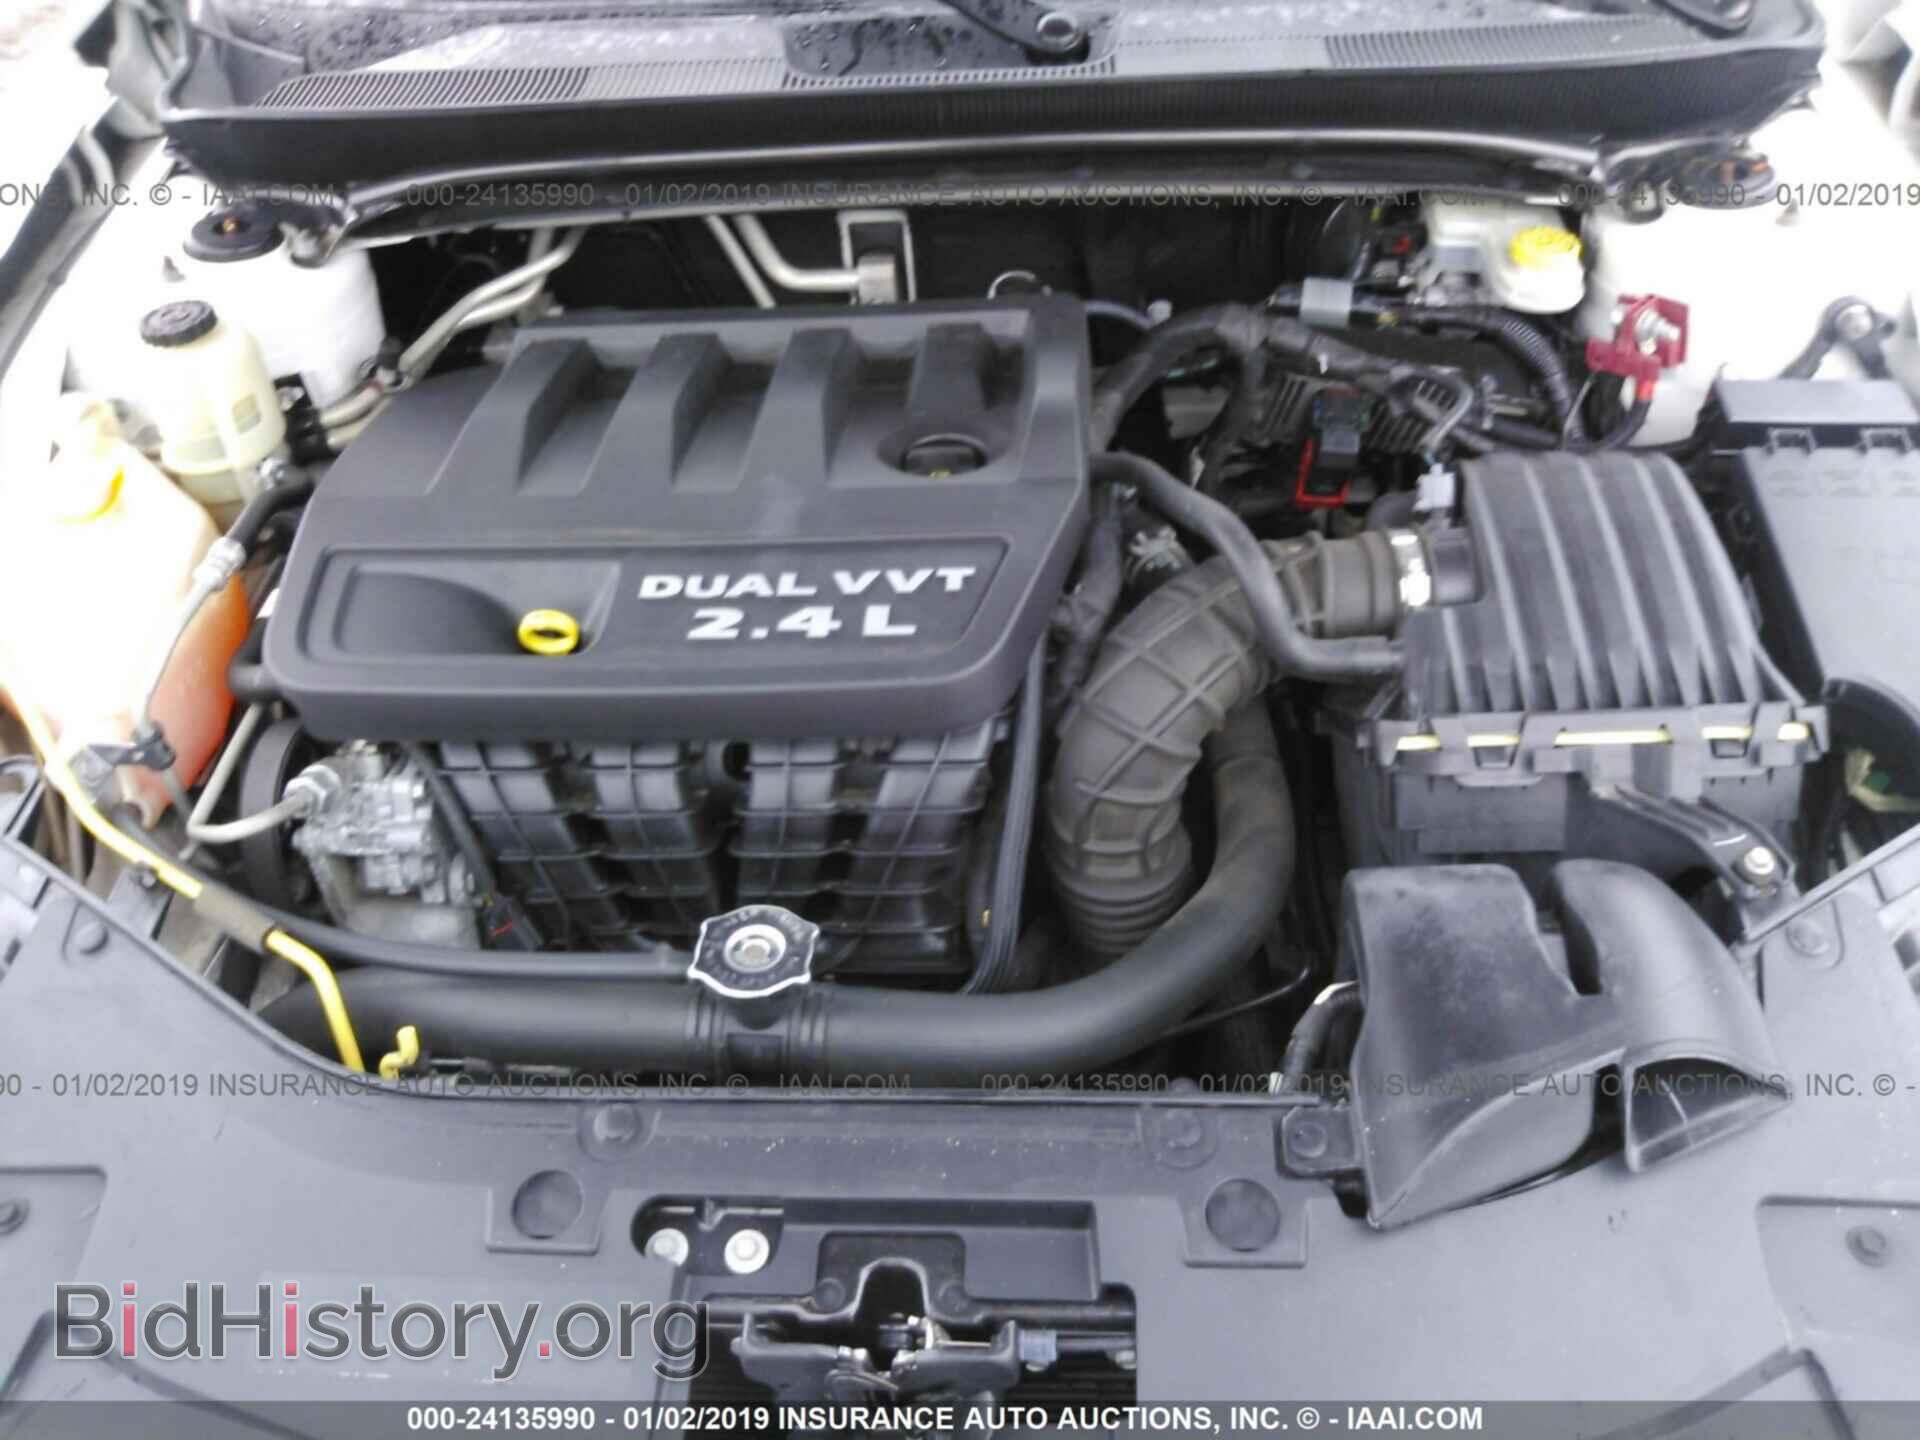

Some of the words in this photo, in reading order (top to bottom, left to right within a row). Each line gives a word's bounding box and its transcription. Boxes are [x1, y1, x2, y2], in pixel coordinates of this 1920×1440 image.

[637, 572, 818, 600] DUAL
[829, 567, 976, 596] VVT
[686, 606, 842, 640] 2.4
[862, 605, 917, 637] L
